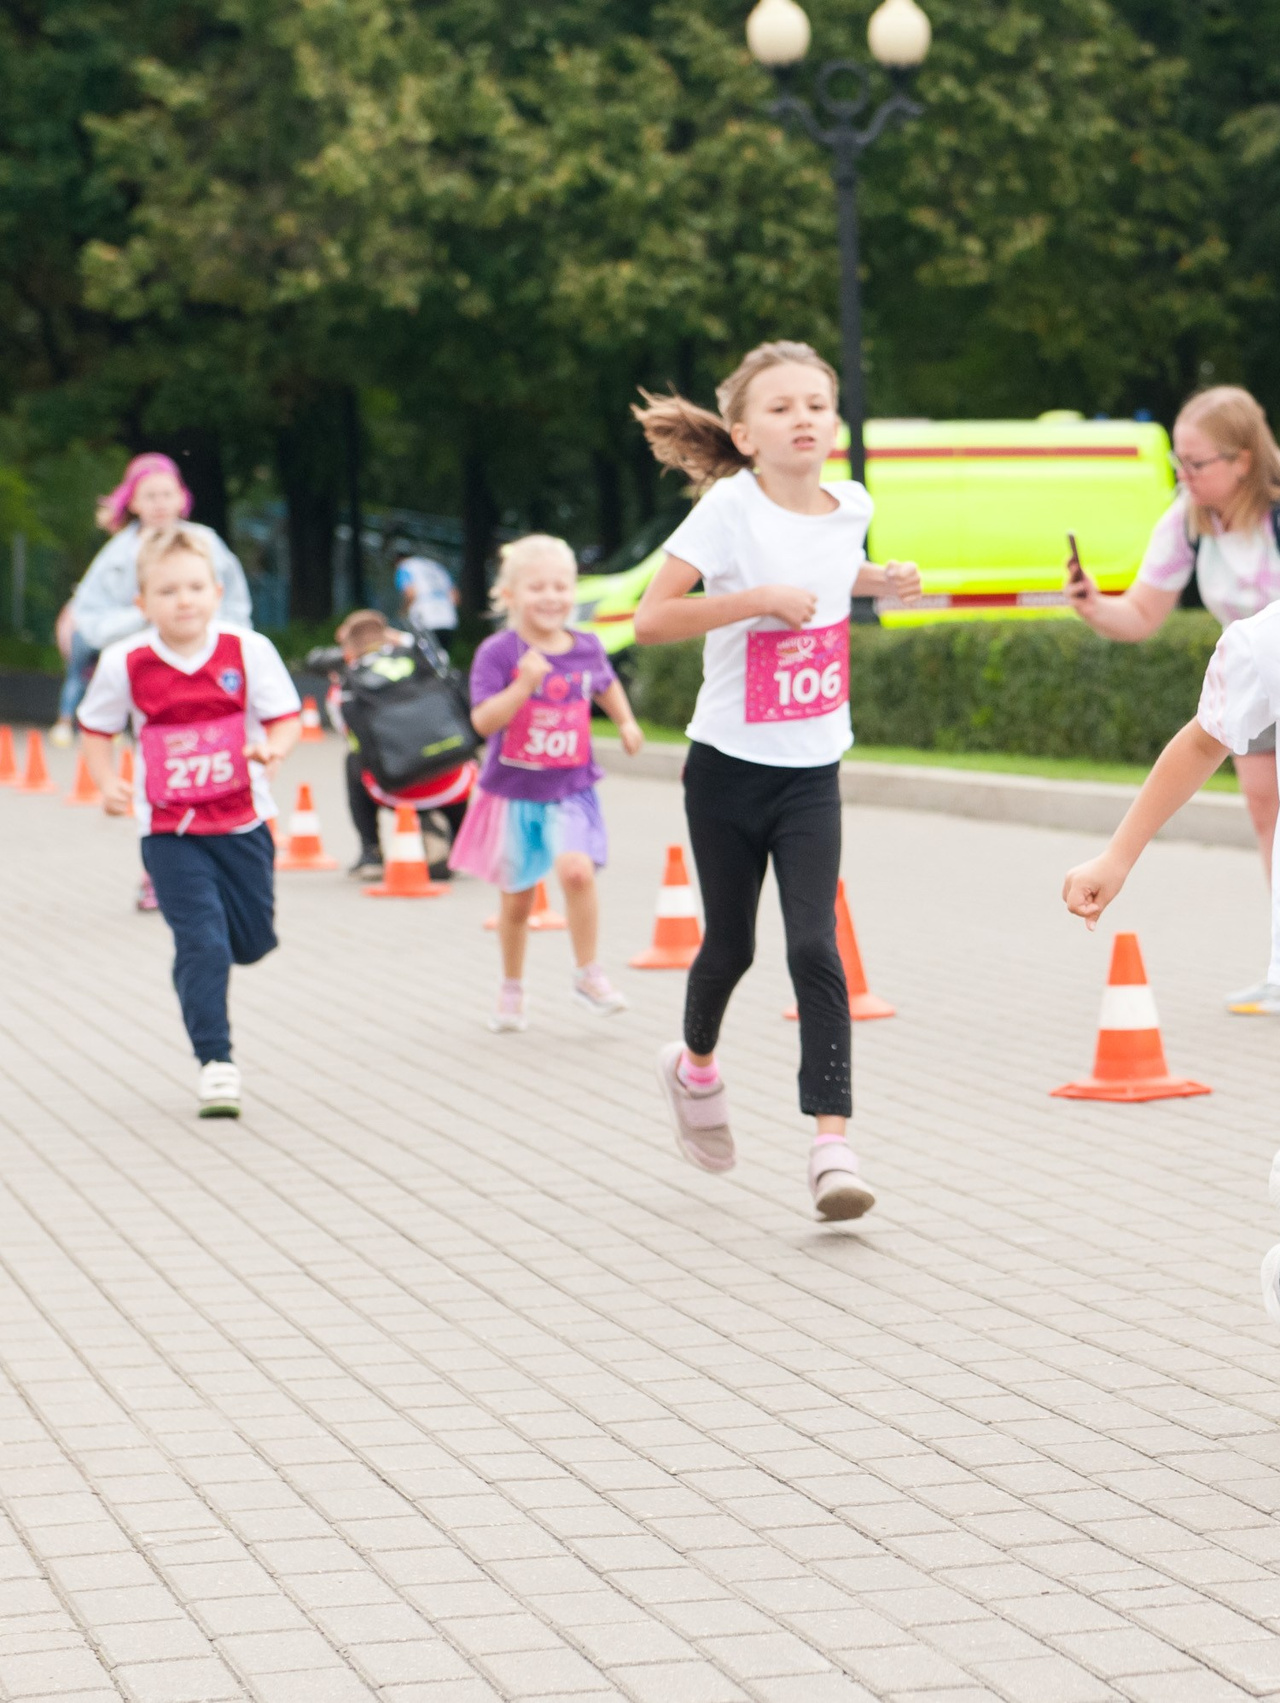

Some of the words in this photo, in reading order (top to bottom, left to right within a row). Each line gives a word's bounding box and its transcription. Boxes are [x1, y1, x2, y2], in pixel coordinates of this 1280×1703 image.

[773, 661, 841, 706] 106
[524, 727, 578, 758] 301
[164, 750, 234, 789] 275
